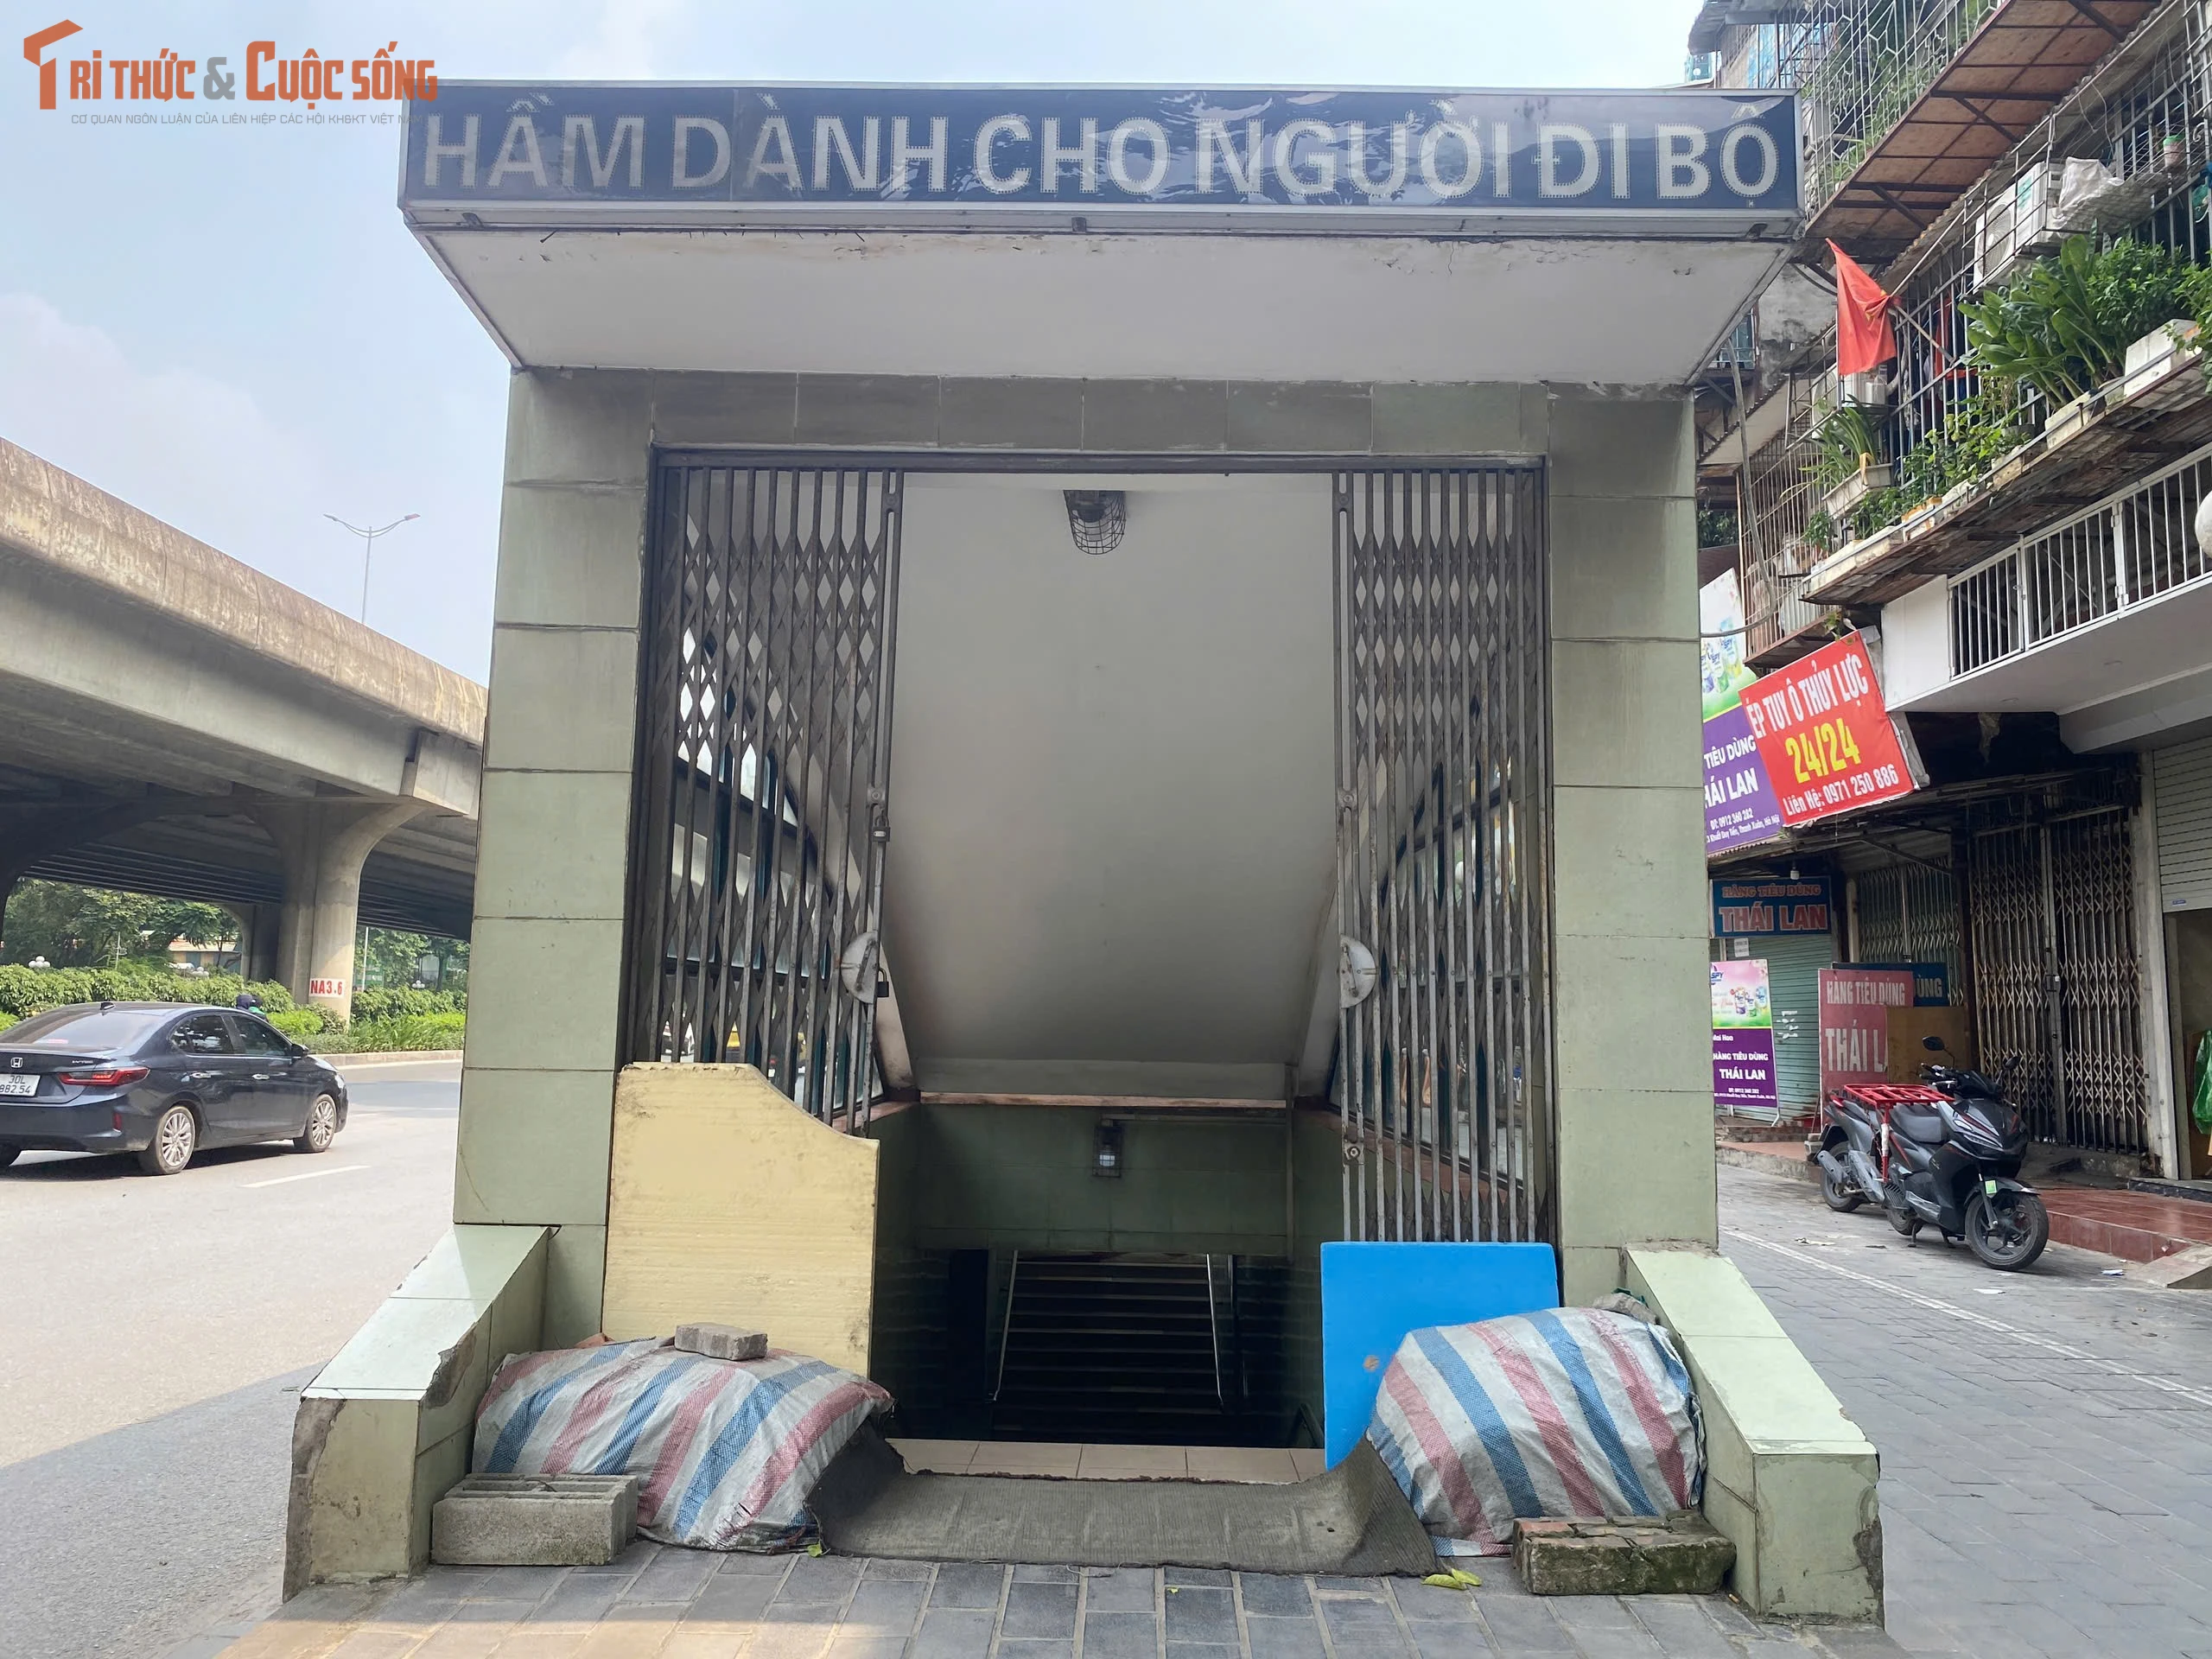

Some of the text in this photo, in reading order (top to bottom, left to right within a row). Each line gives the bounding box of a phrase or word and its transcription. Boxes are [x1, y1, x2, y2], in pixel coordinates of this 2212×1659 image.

[423, 92, 1780, 208] HẦM DÀNH CHO NGƯỜI ĐI BỘ
[1745, 653, 1869, 740] ÉP TUY Ô THỦY LỰC
[1704, 734, 1757, 769] TIÊU DÙNG
[1784, 718, 1861, 784] 24/24
[1726, 767, 1759, 800] LAN
[1783, 764, 1899, 817] Liên Hệ: 0971 250 886
[1722, 882, 1821, 898] HÀNG TIÊU DÙNG
[1719, 901, 1827, 931] THÁI LAN
[311, 980, 342, 995] NA3.6
[1827, 976, 1853, 1004] HÀNG
[1914, 975, 1943, 998] ÙNG
[1732, 1052, 1747, 1060] TIÊU
[1749, 1052, 1769, 1060] DÙNG
[1825, 1020, 1888, 1072] THÁI L
[9, 1075, 25, 1084] 30L
[1719, 1066, 1766, 1080] THÁI LAN
